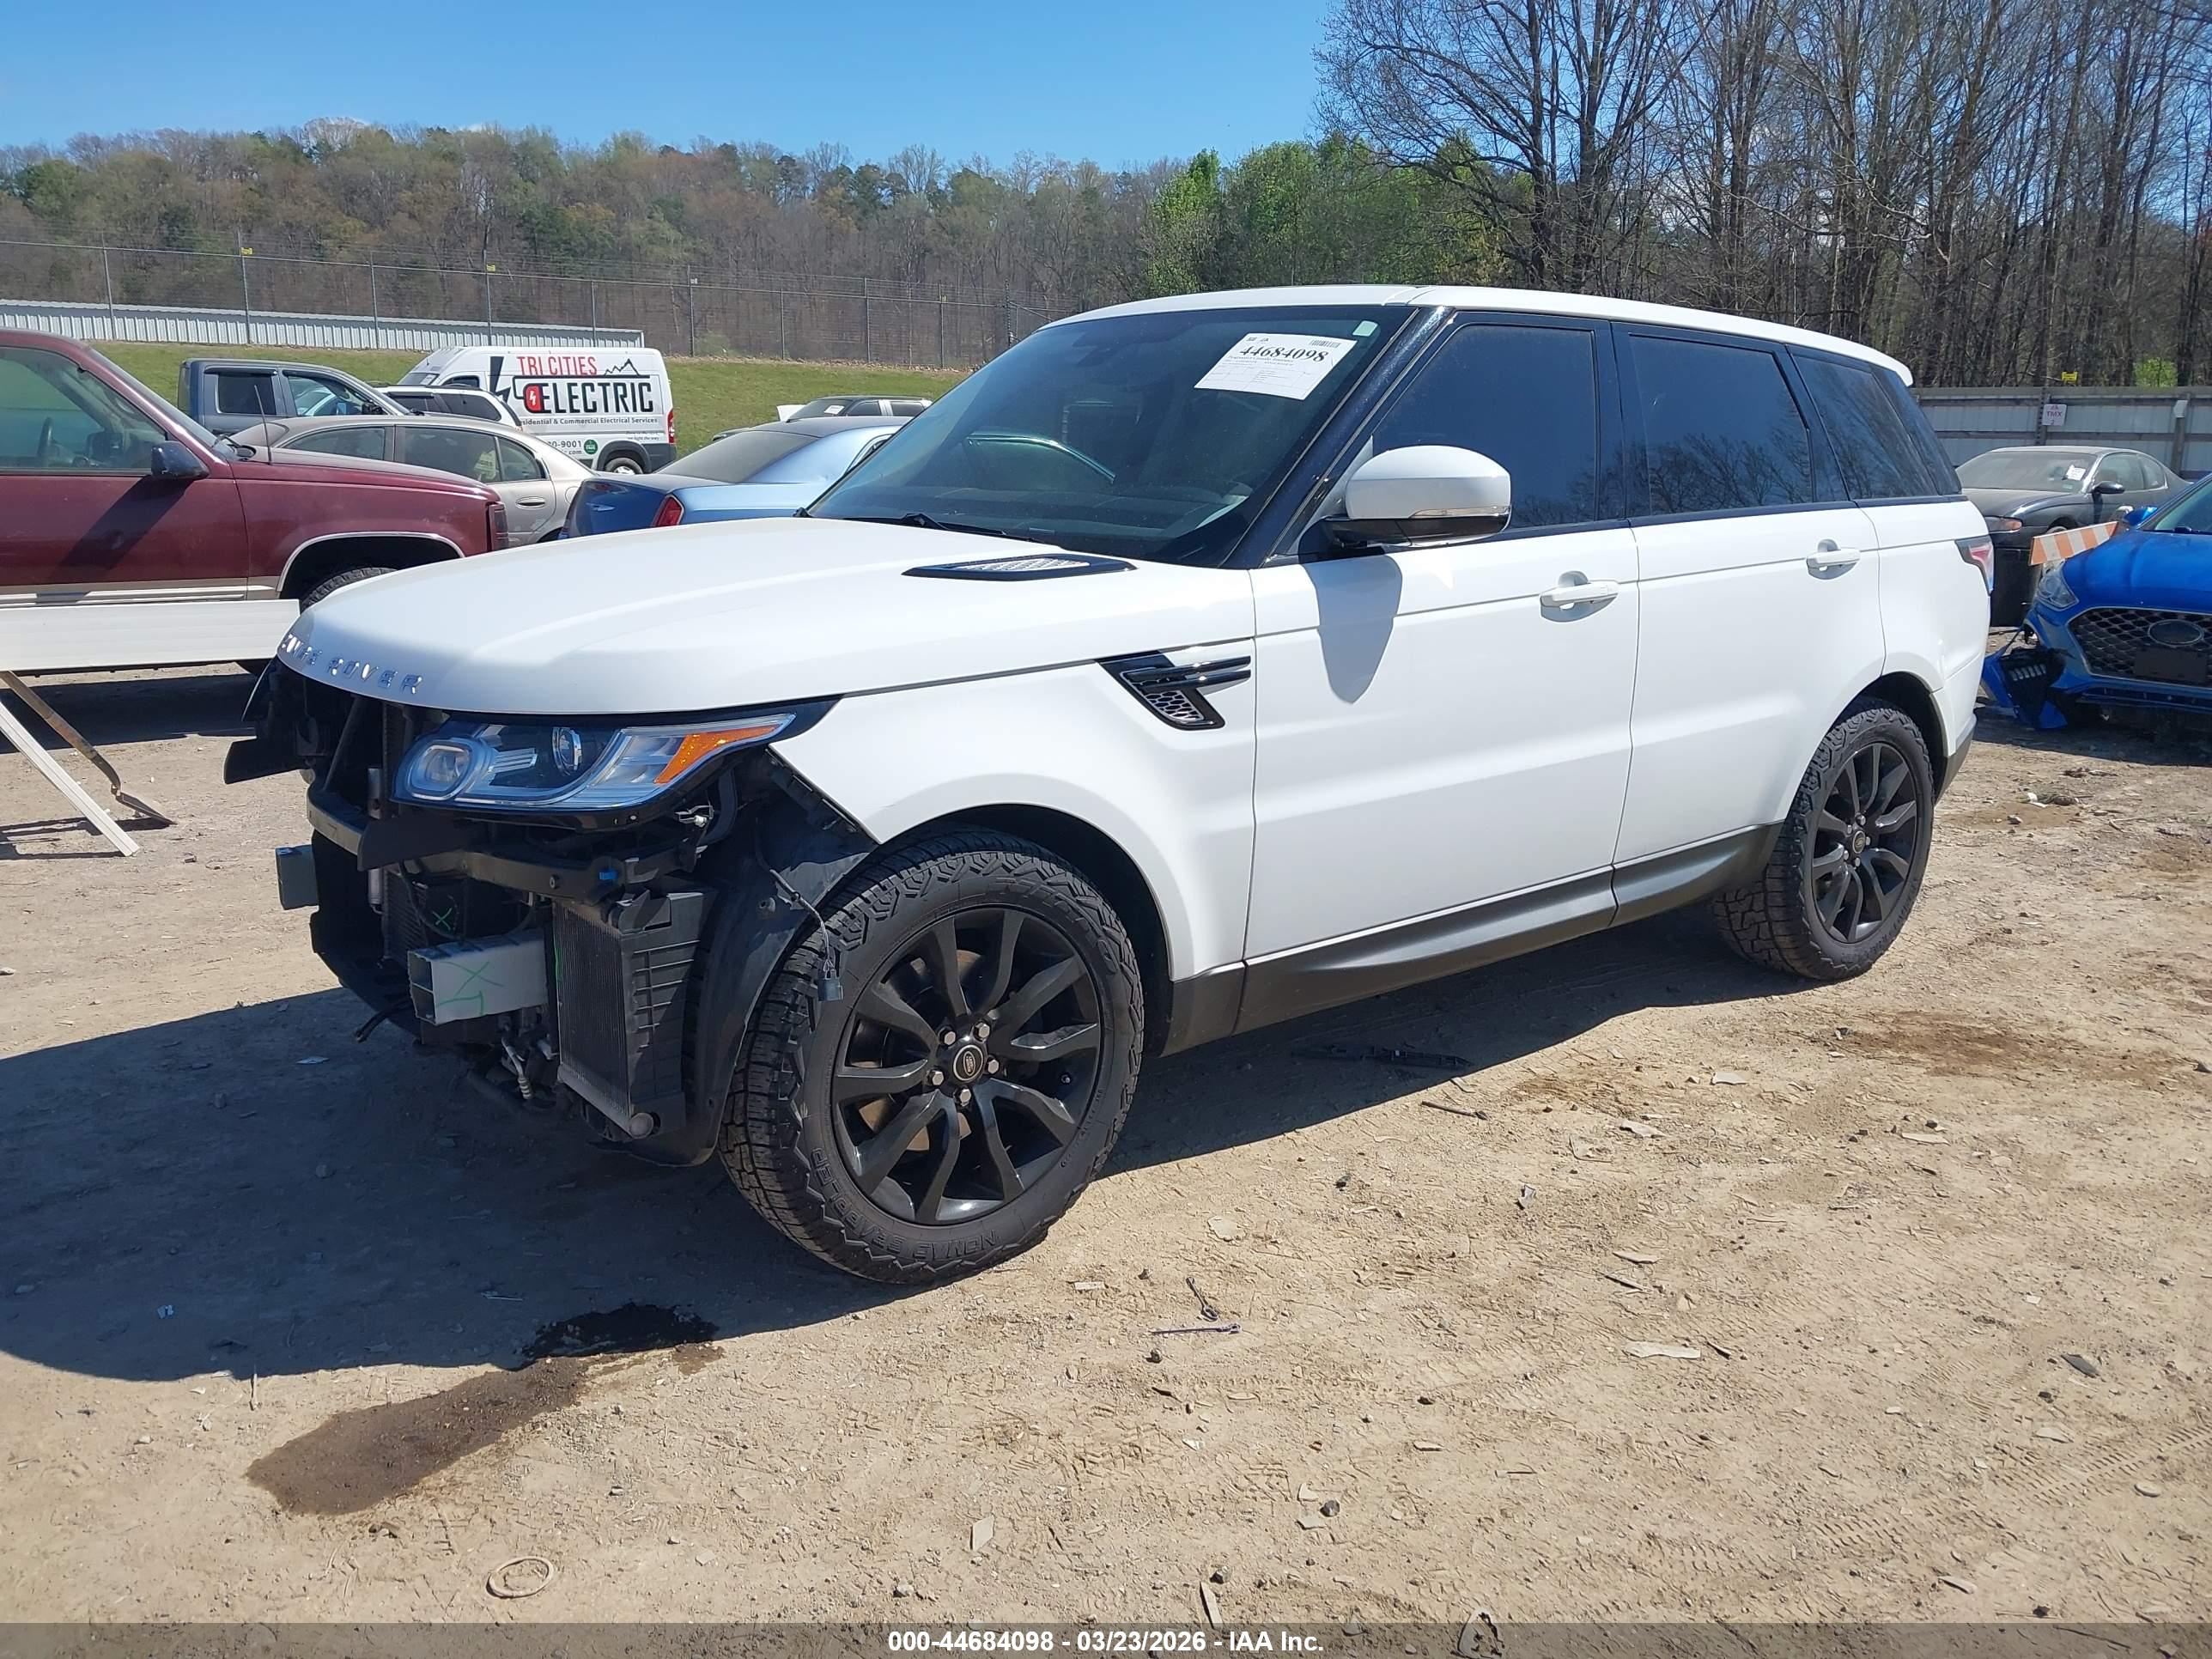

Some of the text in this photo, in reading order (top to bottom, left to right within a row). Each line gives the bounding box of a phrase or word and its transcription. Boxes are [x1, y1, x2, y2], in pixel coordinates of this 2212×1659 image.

[517, 356, 597, 376] TRI CITIES
[1240, 346, 1328, 362] 44684098
[524, 382, 654, 414] ELECTRIC
[326, 655, 423, 695] ROVER
